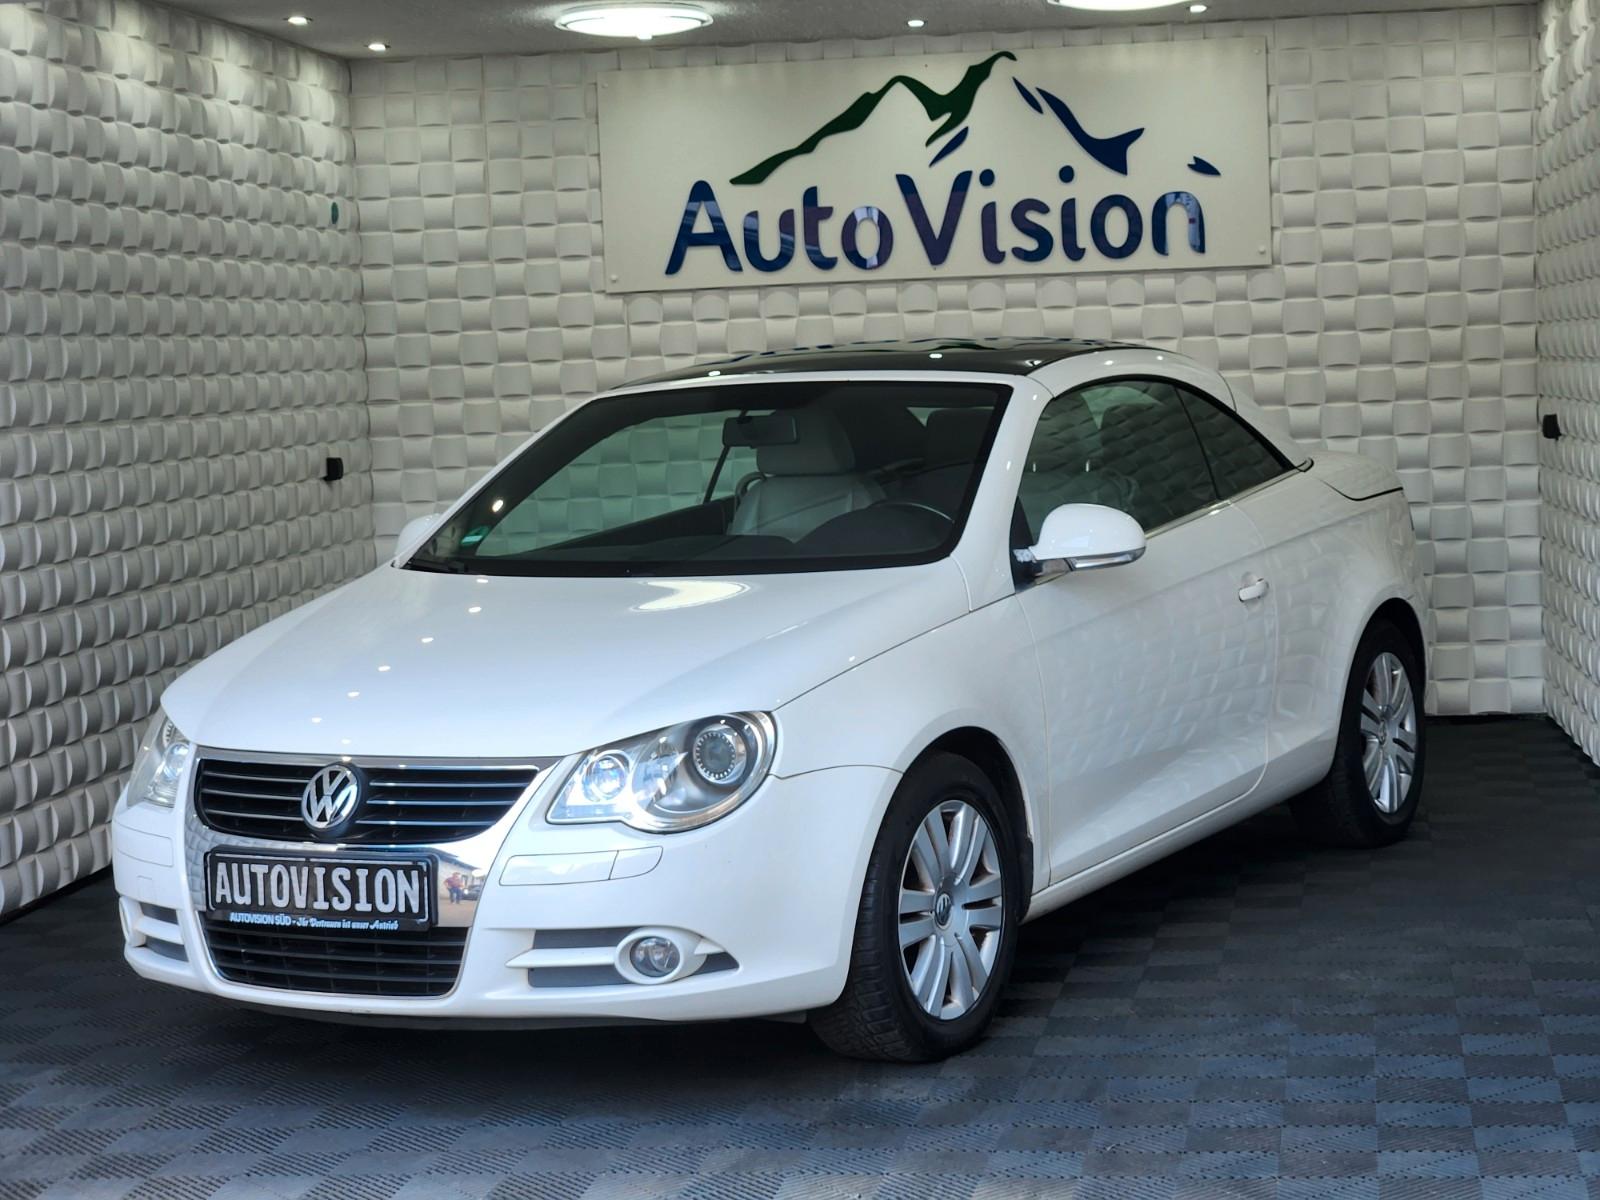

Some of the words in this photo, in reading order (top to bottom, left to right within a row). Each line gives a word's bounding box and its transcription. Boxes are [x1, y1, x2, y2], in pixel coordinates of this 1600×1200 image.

[665, 164, 1206, 275] AutoVision
[302, 765, 358, 829] VW
[215, 861, 421, 914] AUTOVISION
[229, 911, 275, 926] AUTOVISION
[275, 913, 292, 926] SÜD
